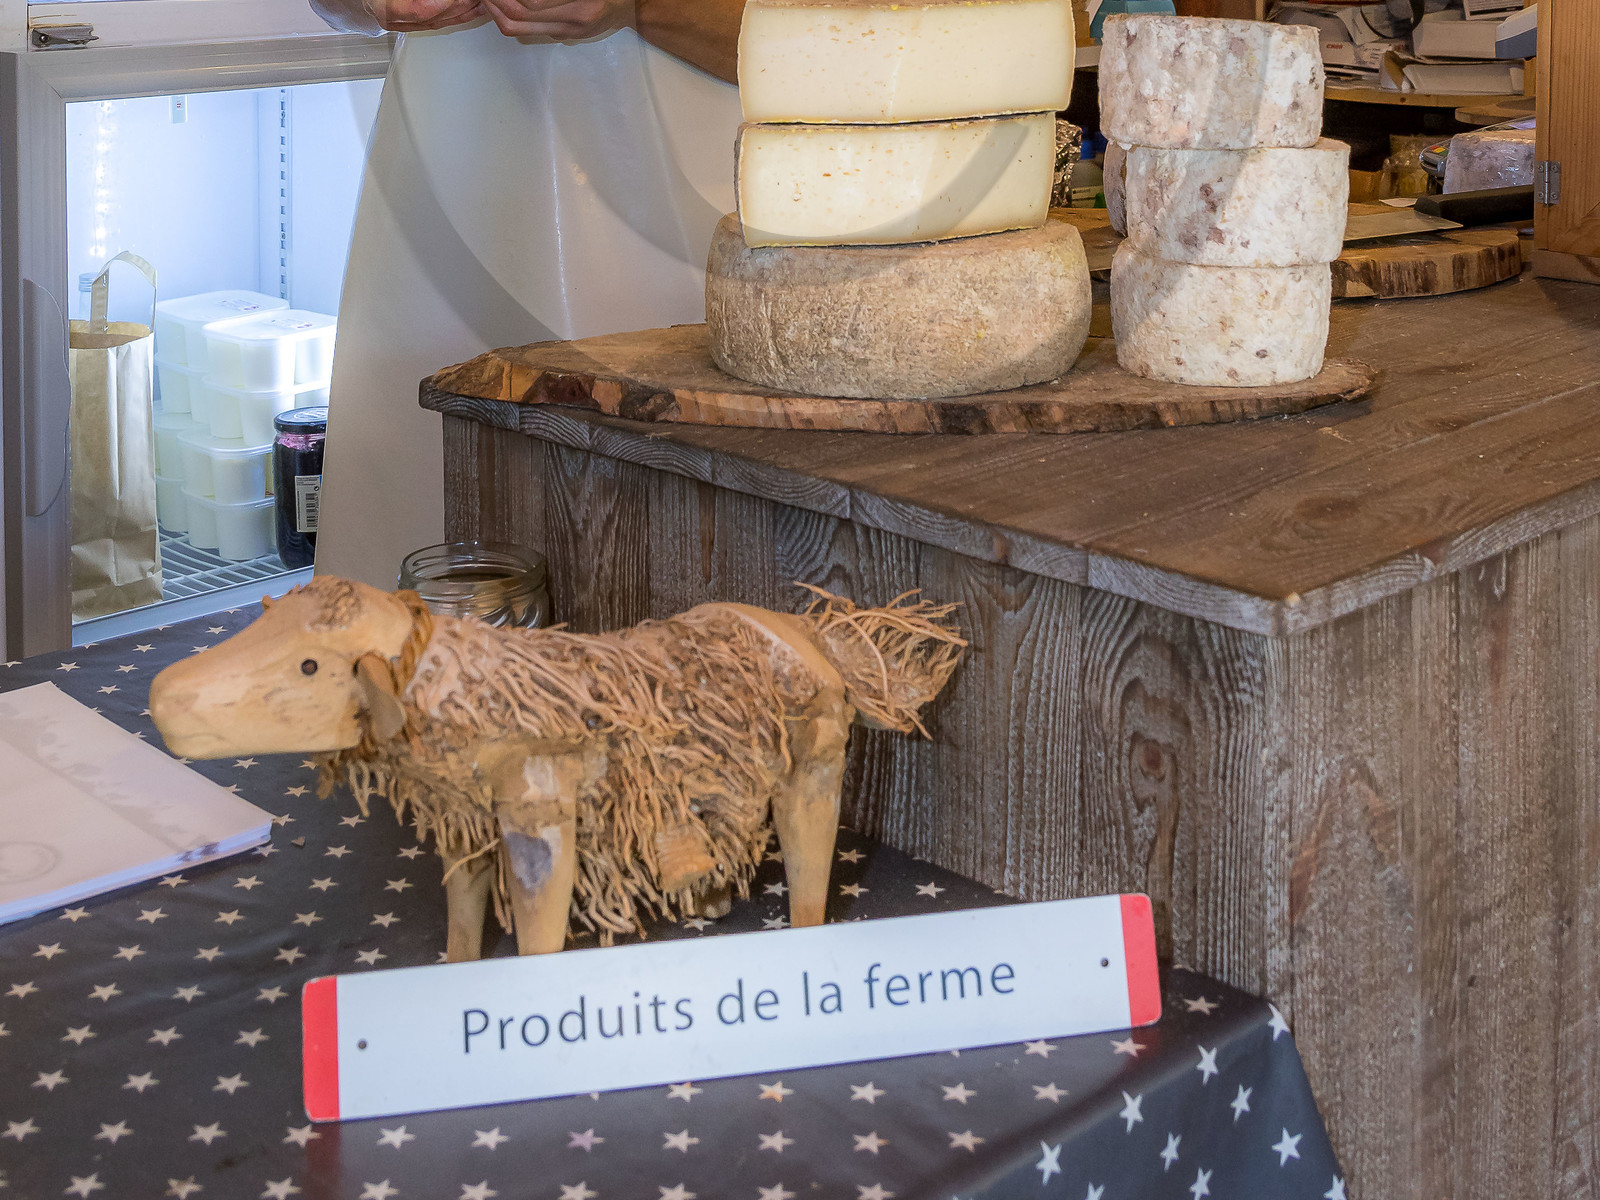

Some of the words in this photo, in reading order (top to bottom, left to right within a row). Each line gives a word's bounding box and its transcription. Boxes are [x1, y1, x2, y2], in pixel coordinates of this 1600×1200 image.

[462, 990, 694, 1054] Produits
[716, 978, 780, 1026] de
[802, 971, 844, 1018] la
[864, 962, 1016, 1010] ferme
